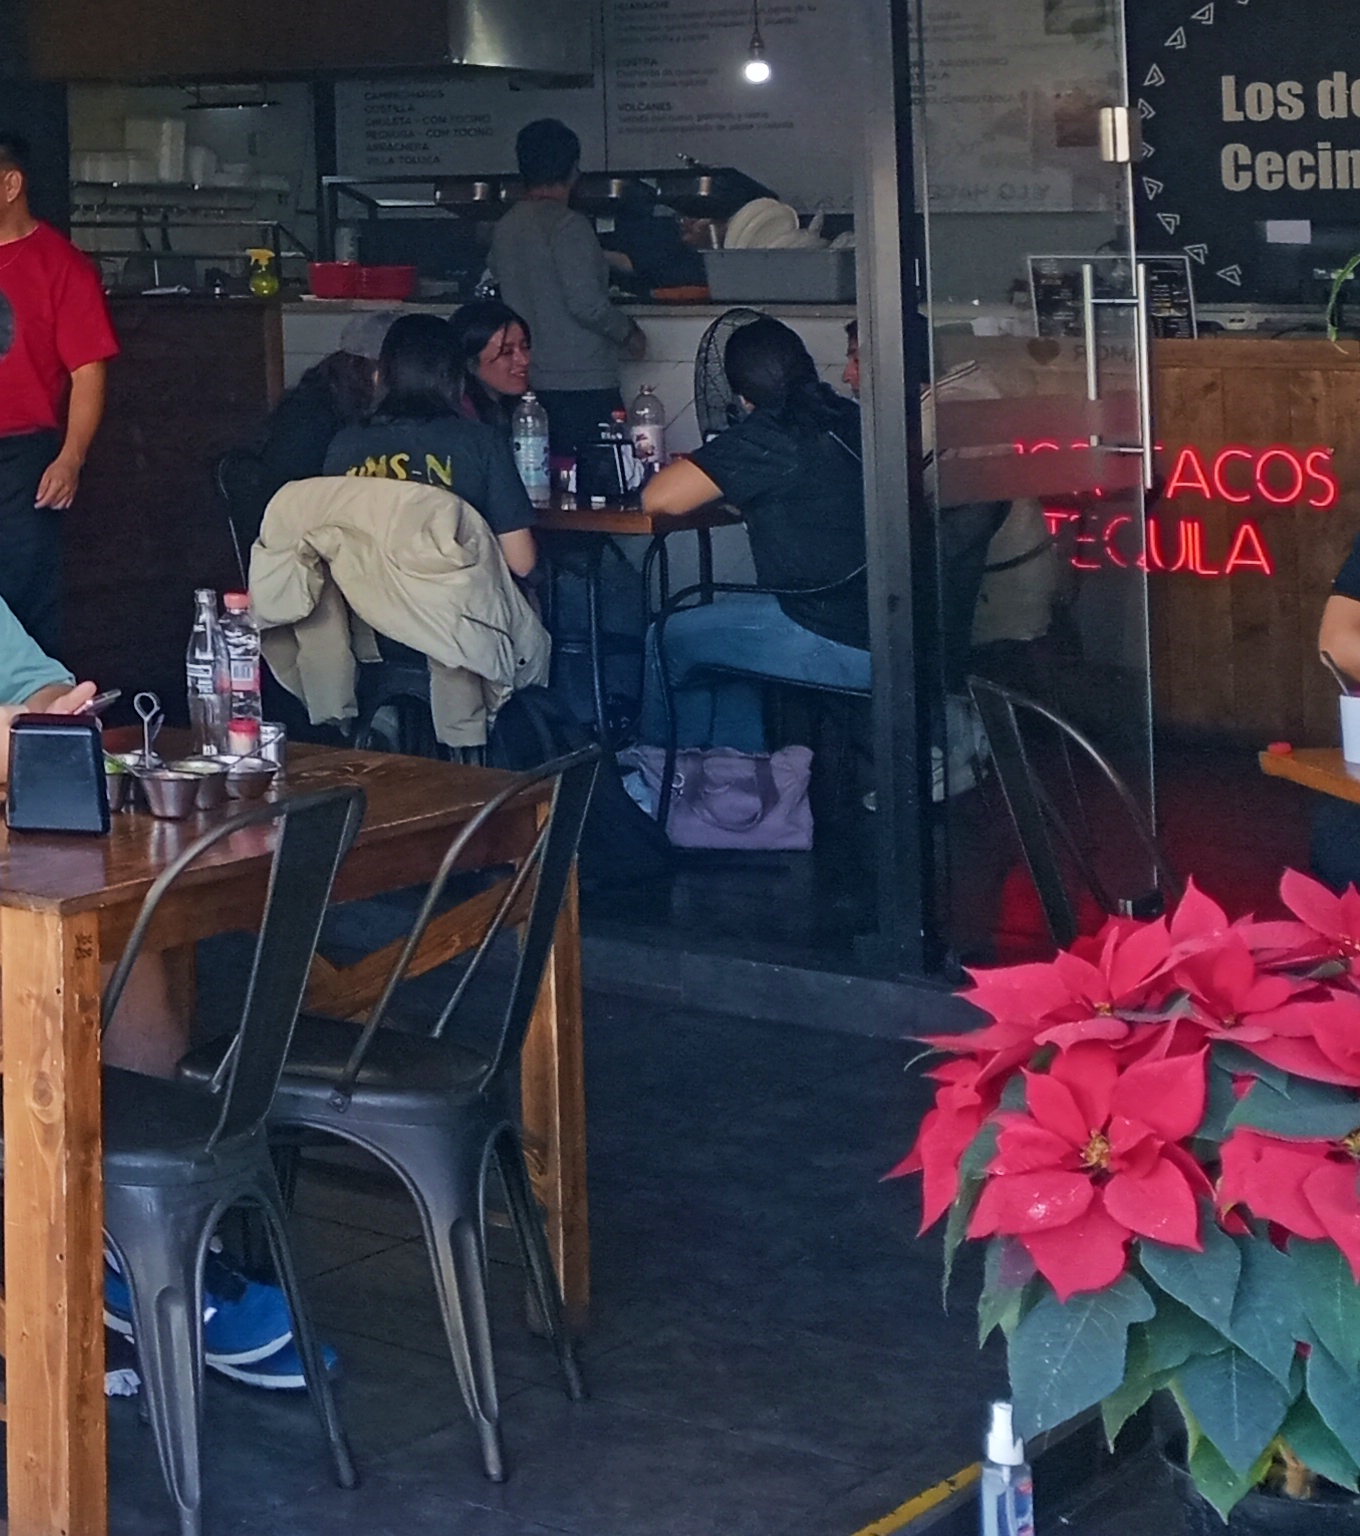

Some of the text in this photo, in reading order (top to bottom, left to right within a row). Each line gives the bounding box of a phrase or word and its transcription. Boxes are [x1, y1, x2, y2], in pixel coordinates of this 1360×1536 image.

[1221, 74, 1305, 122] Los
[1221, 141, 1360, 192] Cecin
[1148, 444, 1337, 508] ACOS
[1042, 510, 1272, 576] TEQUILA
